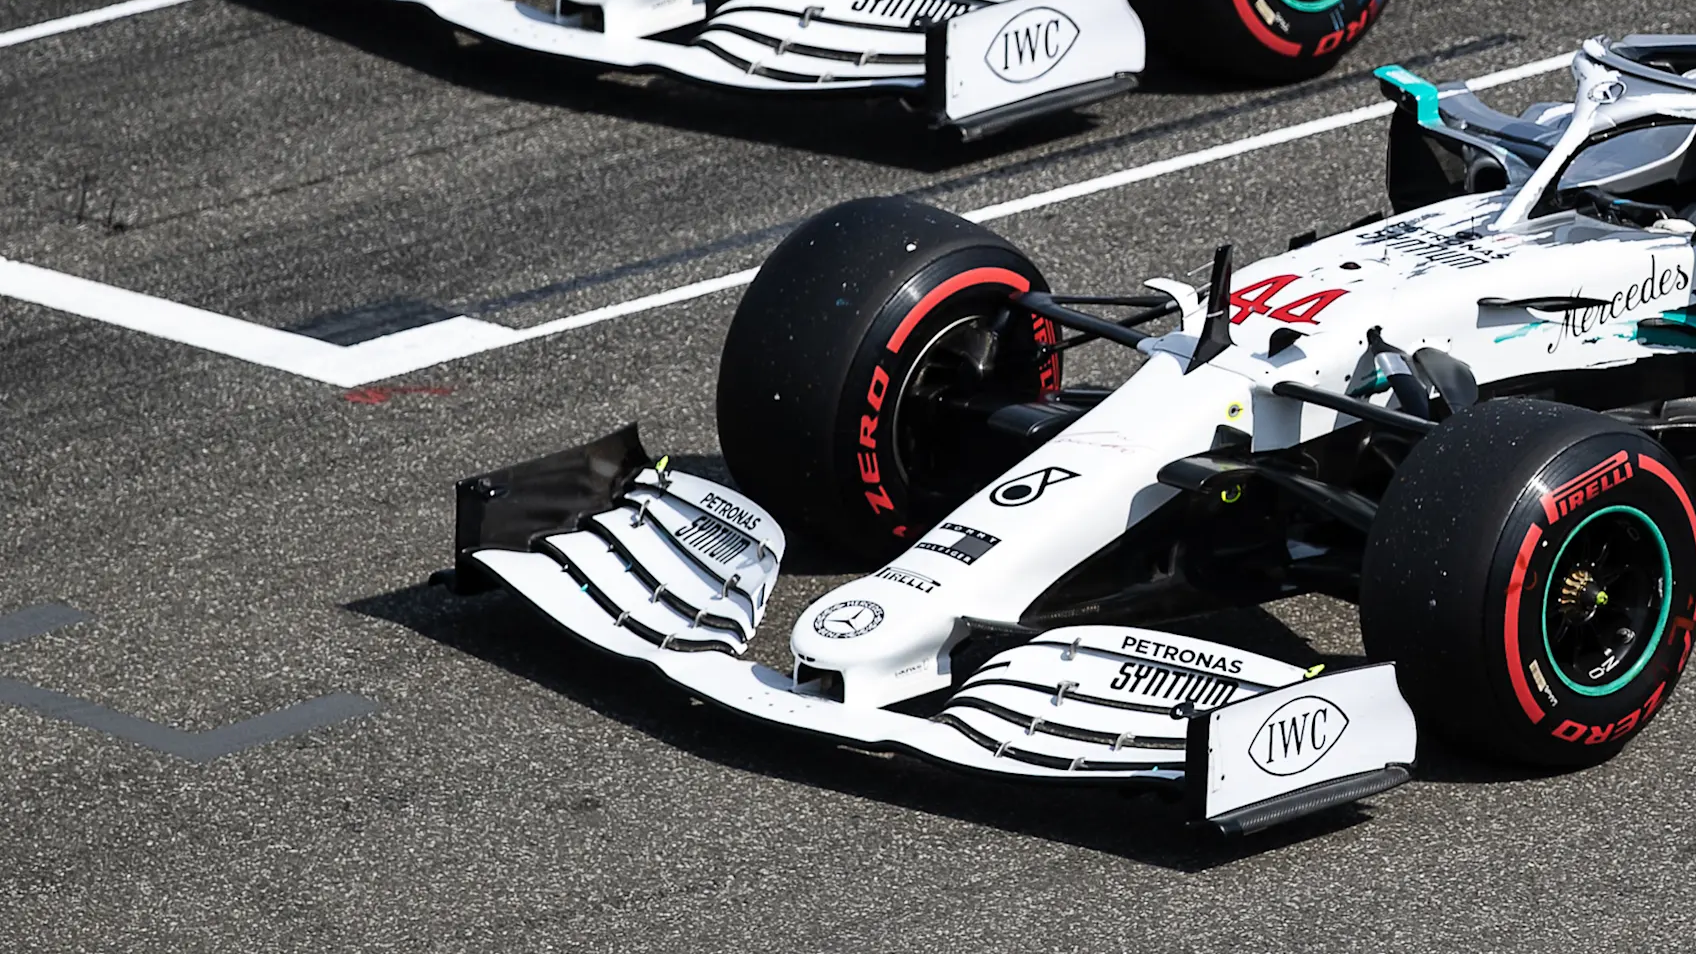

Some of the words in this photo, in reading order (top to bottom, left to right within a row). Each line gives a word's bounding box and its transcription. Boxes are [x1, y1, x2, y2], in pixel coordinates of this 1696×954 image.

[1003, 19, 1060, 70] IWC
[1229, 273, 1351, 326] 44
[1547, 253, 1690, 354] Mercedes
[856, 364, 893, 516] ZERO
[699, 492, 762, 531] PETRONAS
[1538, 449, 1634, 526] PIRELLI
[674, 515, 752, 565] SYNTIUM
[874, 565, 942, 595] PIRELLI
[1121, 636, 1244, 675] PETRONAS
[1110, 662, 1239, 708] SYNTIUM
[1266, 708, 1328, 763] IWC
[1550, 680, 1668, 746] ZERO
